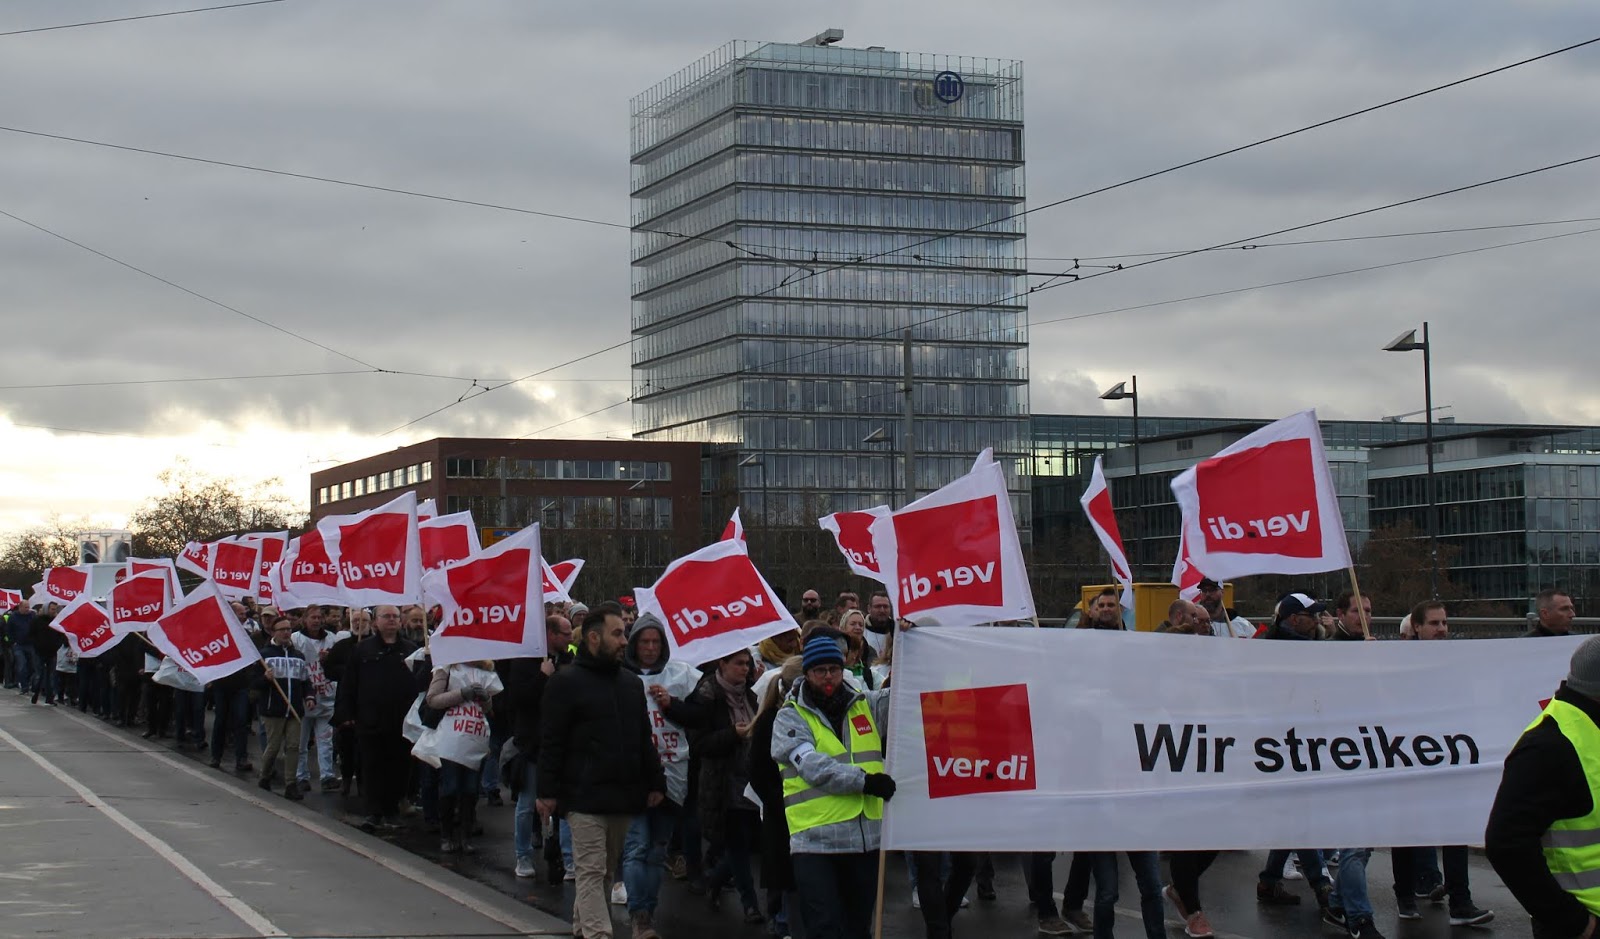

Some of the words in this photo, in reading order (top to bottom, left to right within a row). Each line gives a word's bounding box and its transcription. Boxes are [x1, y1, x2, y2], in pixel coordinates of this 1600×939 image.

[1134, 723, 1235, 773] Wir
[1254, 725, 1480, 773] streiken
[932, 754, 1028, 781] ver.di
